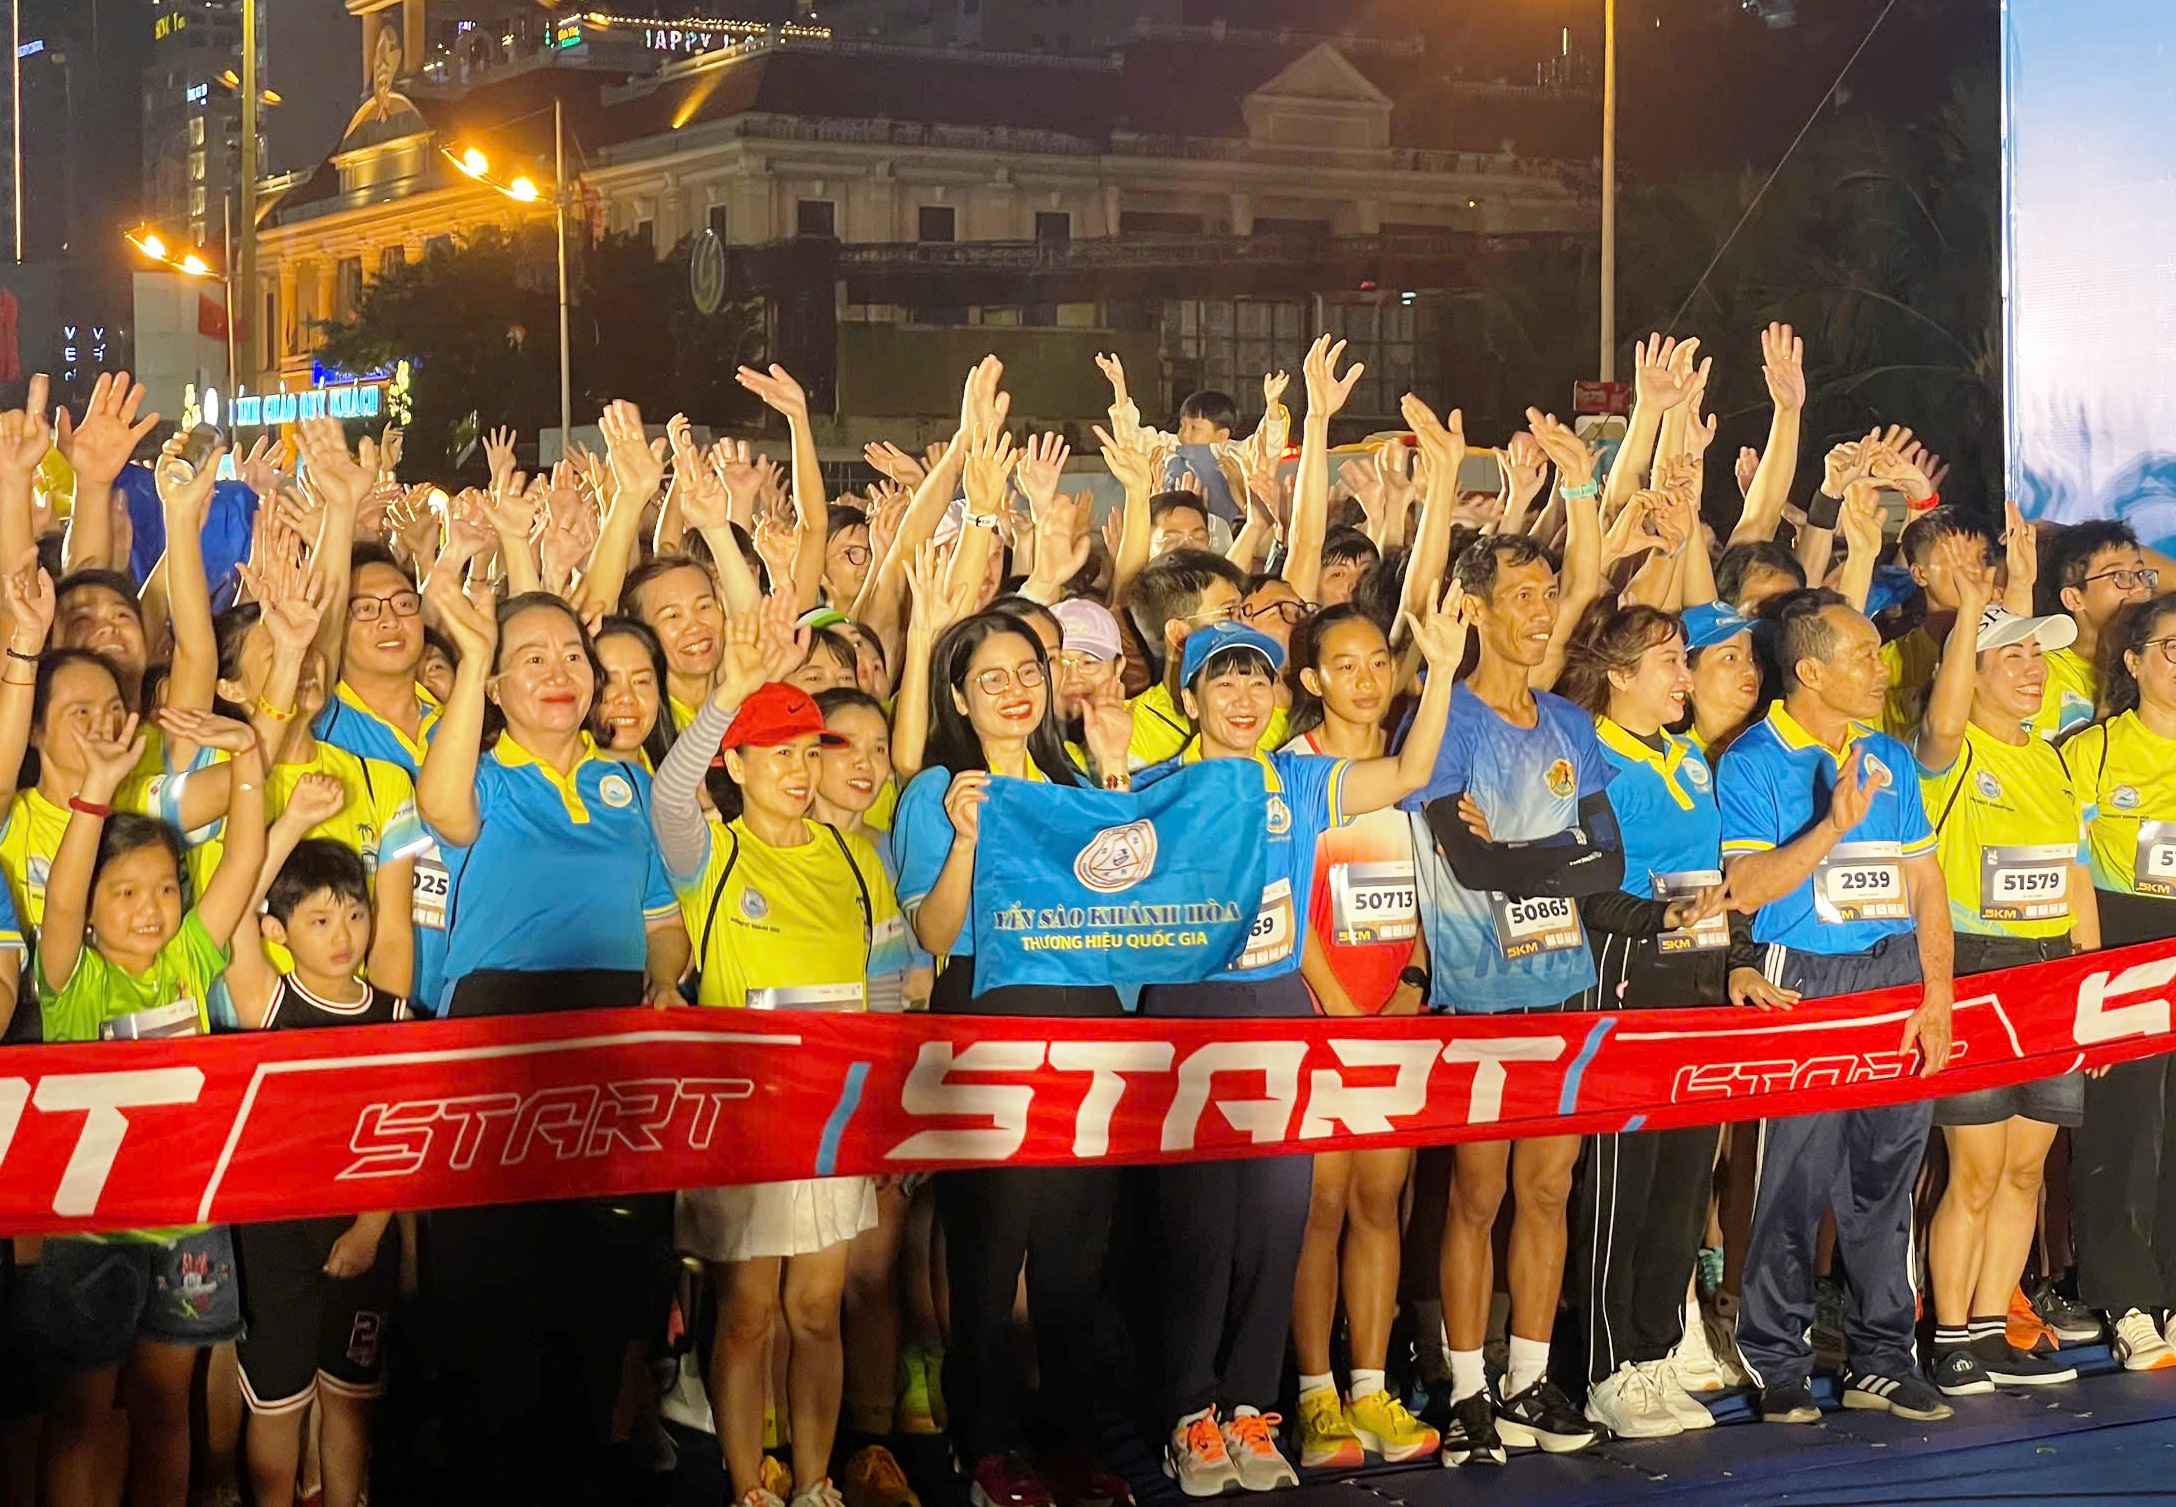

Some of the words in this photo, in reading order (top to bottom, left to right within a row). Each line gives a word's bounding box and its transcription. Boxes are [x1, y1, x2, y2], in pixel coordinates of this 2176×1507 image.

[1840, 871, 1890, 889] 2939
[2003, 872, 2060, 890] 51579
[2138, 882, 2171, 894] 5KM
[1355, 891, 1413, 910] 50713
[1038, 903, 1085, 928] SÀO
[1087, 901, 1181, 927] KHÁNH
[1185, 898, 1242, 924] HÒA
[1511, 898, 1569, 925] 50865
[1021, 934, 1082, 951] THƯƠNG
[1085, 932, 1123, 952] HIỆU
[1126, 929, 1176, 949] QUỐC
[1178, 931, 1208, 946] GIA
[1507, 942, 1539, 957] 5KM
[1662, 938, 1691, 950] 5KM
[883, 1035, 1567, 1160] START
[334, 1078, 755, 1181] START
